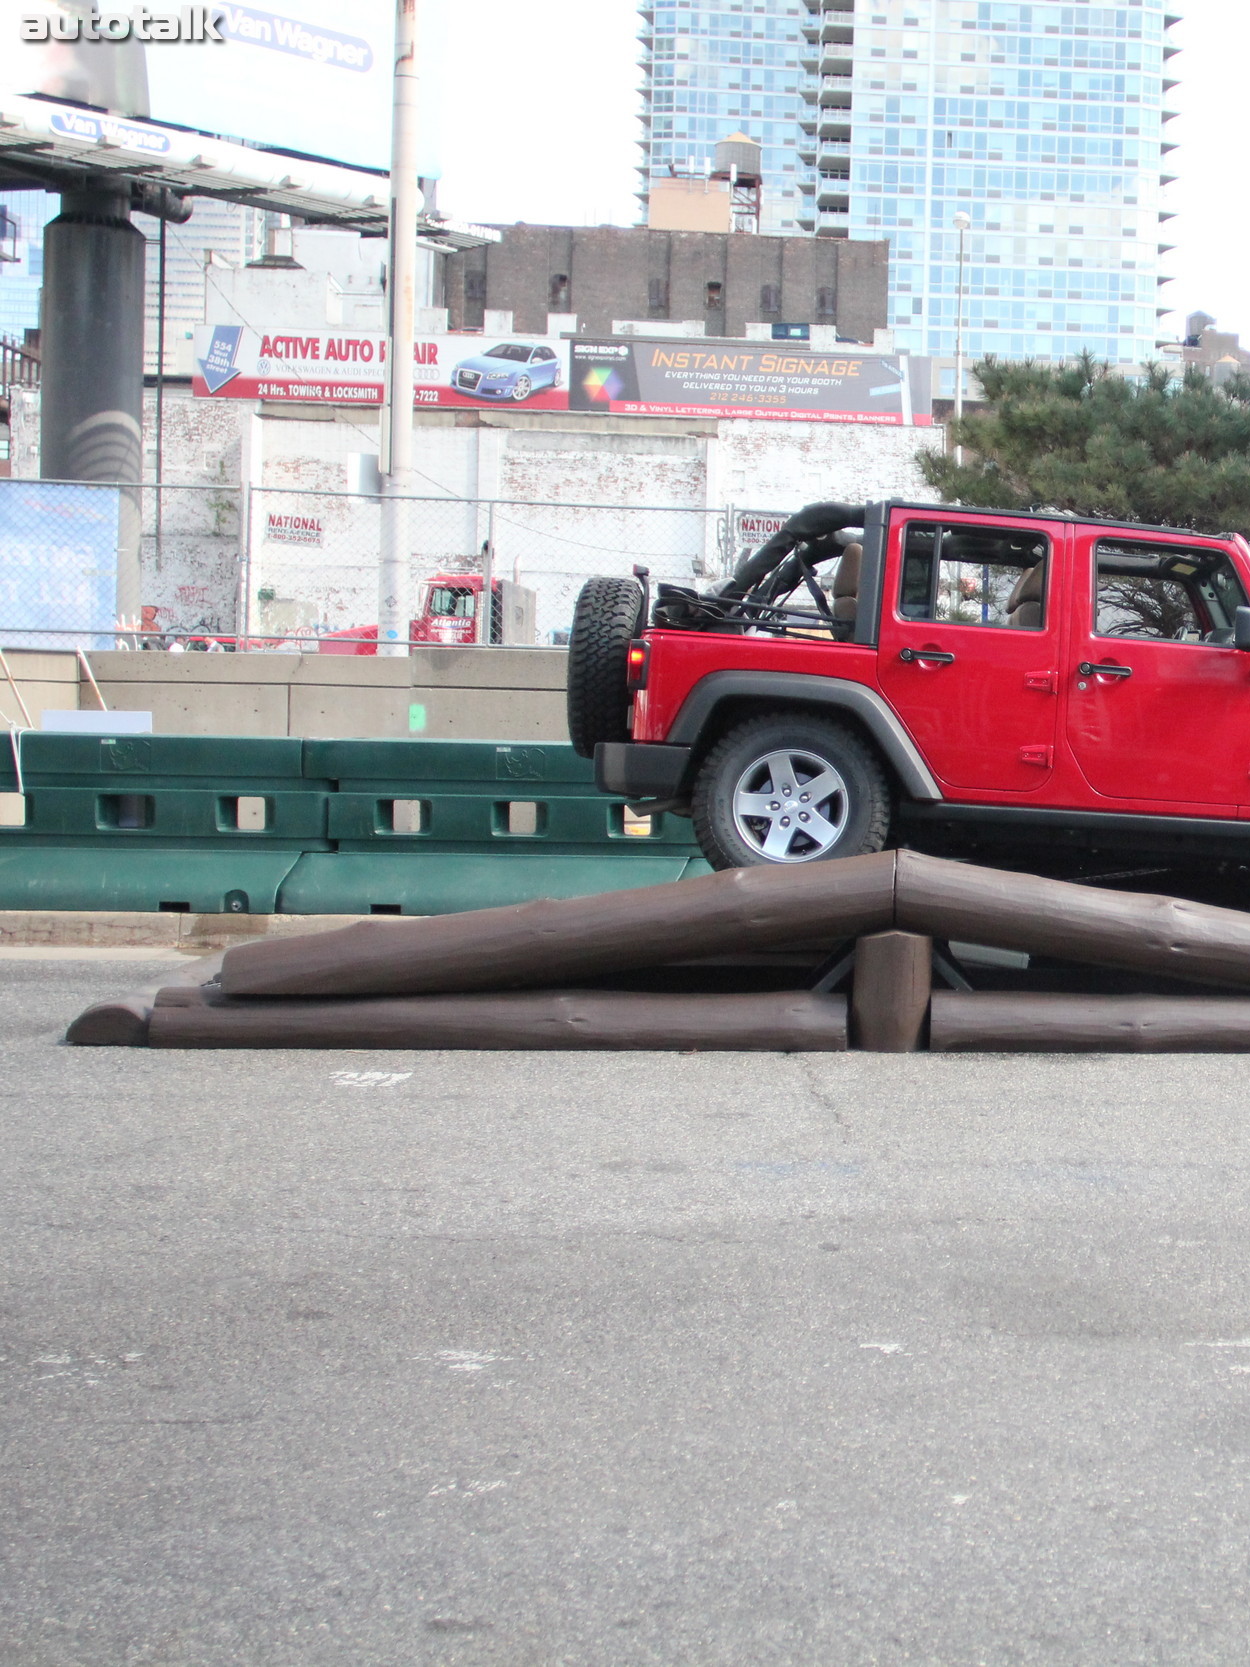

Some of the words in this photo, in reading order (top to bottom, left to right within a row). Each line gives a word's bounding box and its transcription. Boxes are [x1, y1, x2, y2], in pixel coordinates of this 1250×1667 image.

[221, 6, 271, 38] Van
[273, 18, 369, 67] Wagner
[61, 114, 96, 136] Van
[100, 119, 166, 151] Wagner
[259, 335, 320, 359] ACTIVE
[324, 338, 374, 363] AUTO
[275, 364, 332, 375] VOLKSWAGEN
[341, 367, 361, 377] AUDI
[651, 348, 754, 372] INSTANT
[759, 353, 863, 377] SIGNAGE
[664, 371, 721, 381] EVERYTHING
[722, 372, 741, 382] YOU
[742, 374, 765, 383] NEED
[766, 375, 784, 383] FOR
[785, 376, 810, 385] YOUR
[811, 377, 842, 386] BOOTH
[258, 383, 268, 395] 24
[270, 383, 287, 396] Hrs.
[288, 385, 322, 398] TOWING
[324, 386, 331, 397] &
[333, 386, 378, 399] LOCKSMITH
[682, 381, 732, 391] DELIVERED
[733, 383, 746, 391] TO
[748, 384, 767, 393] YOU
[768, 385, 777, 393] IN
[778, 384, 786, 394] 3
[788, 386, 819, 395] HOURS
[709, 392, 727, 401] 212
[729, 392, 787, 404] 246-3355
[625, 403, 638, 411] 3D
[649, 404, 674, 413] VINYL
[675, 405, 724, 415] LETTERING,
[725, 408, 753, 416] LARGE
[755, 409, 788, 418] OUTPUT
[791, 410, 821, 419] DIGITAL
[857, 414, 897, 422] BANNERS
[268, 514, 322, 532] NATIONAL
[742, 518, 786, 532] NATION
[431, 618, 472, 628] Atlantic
